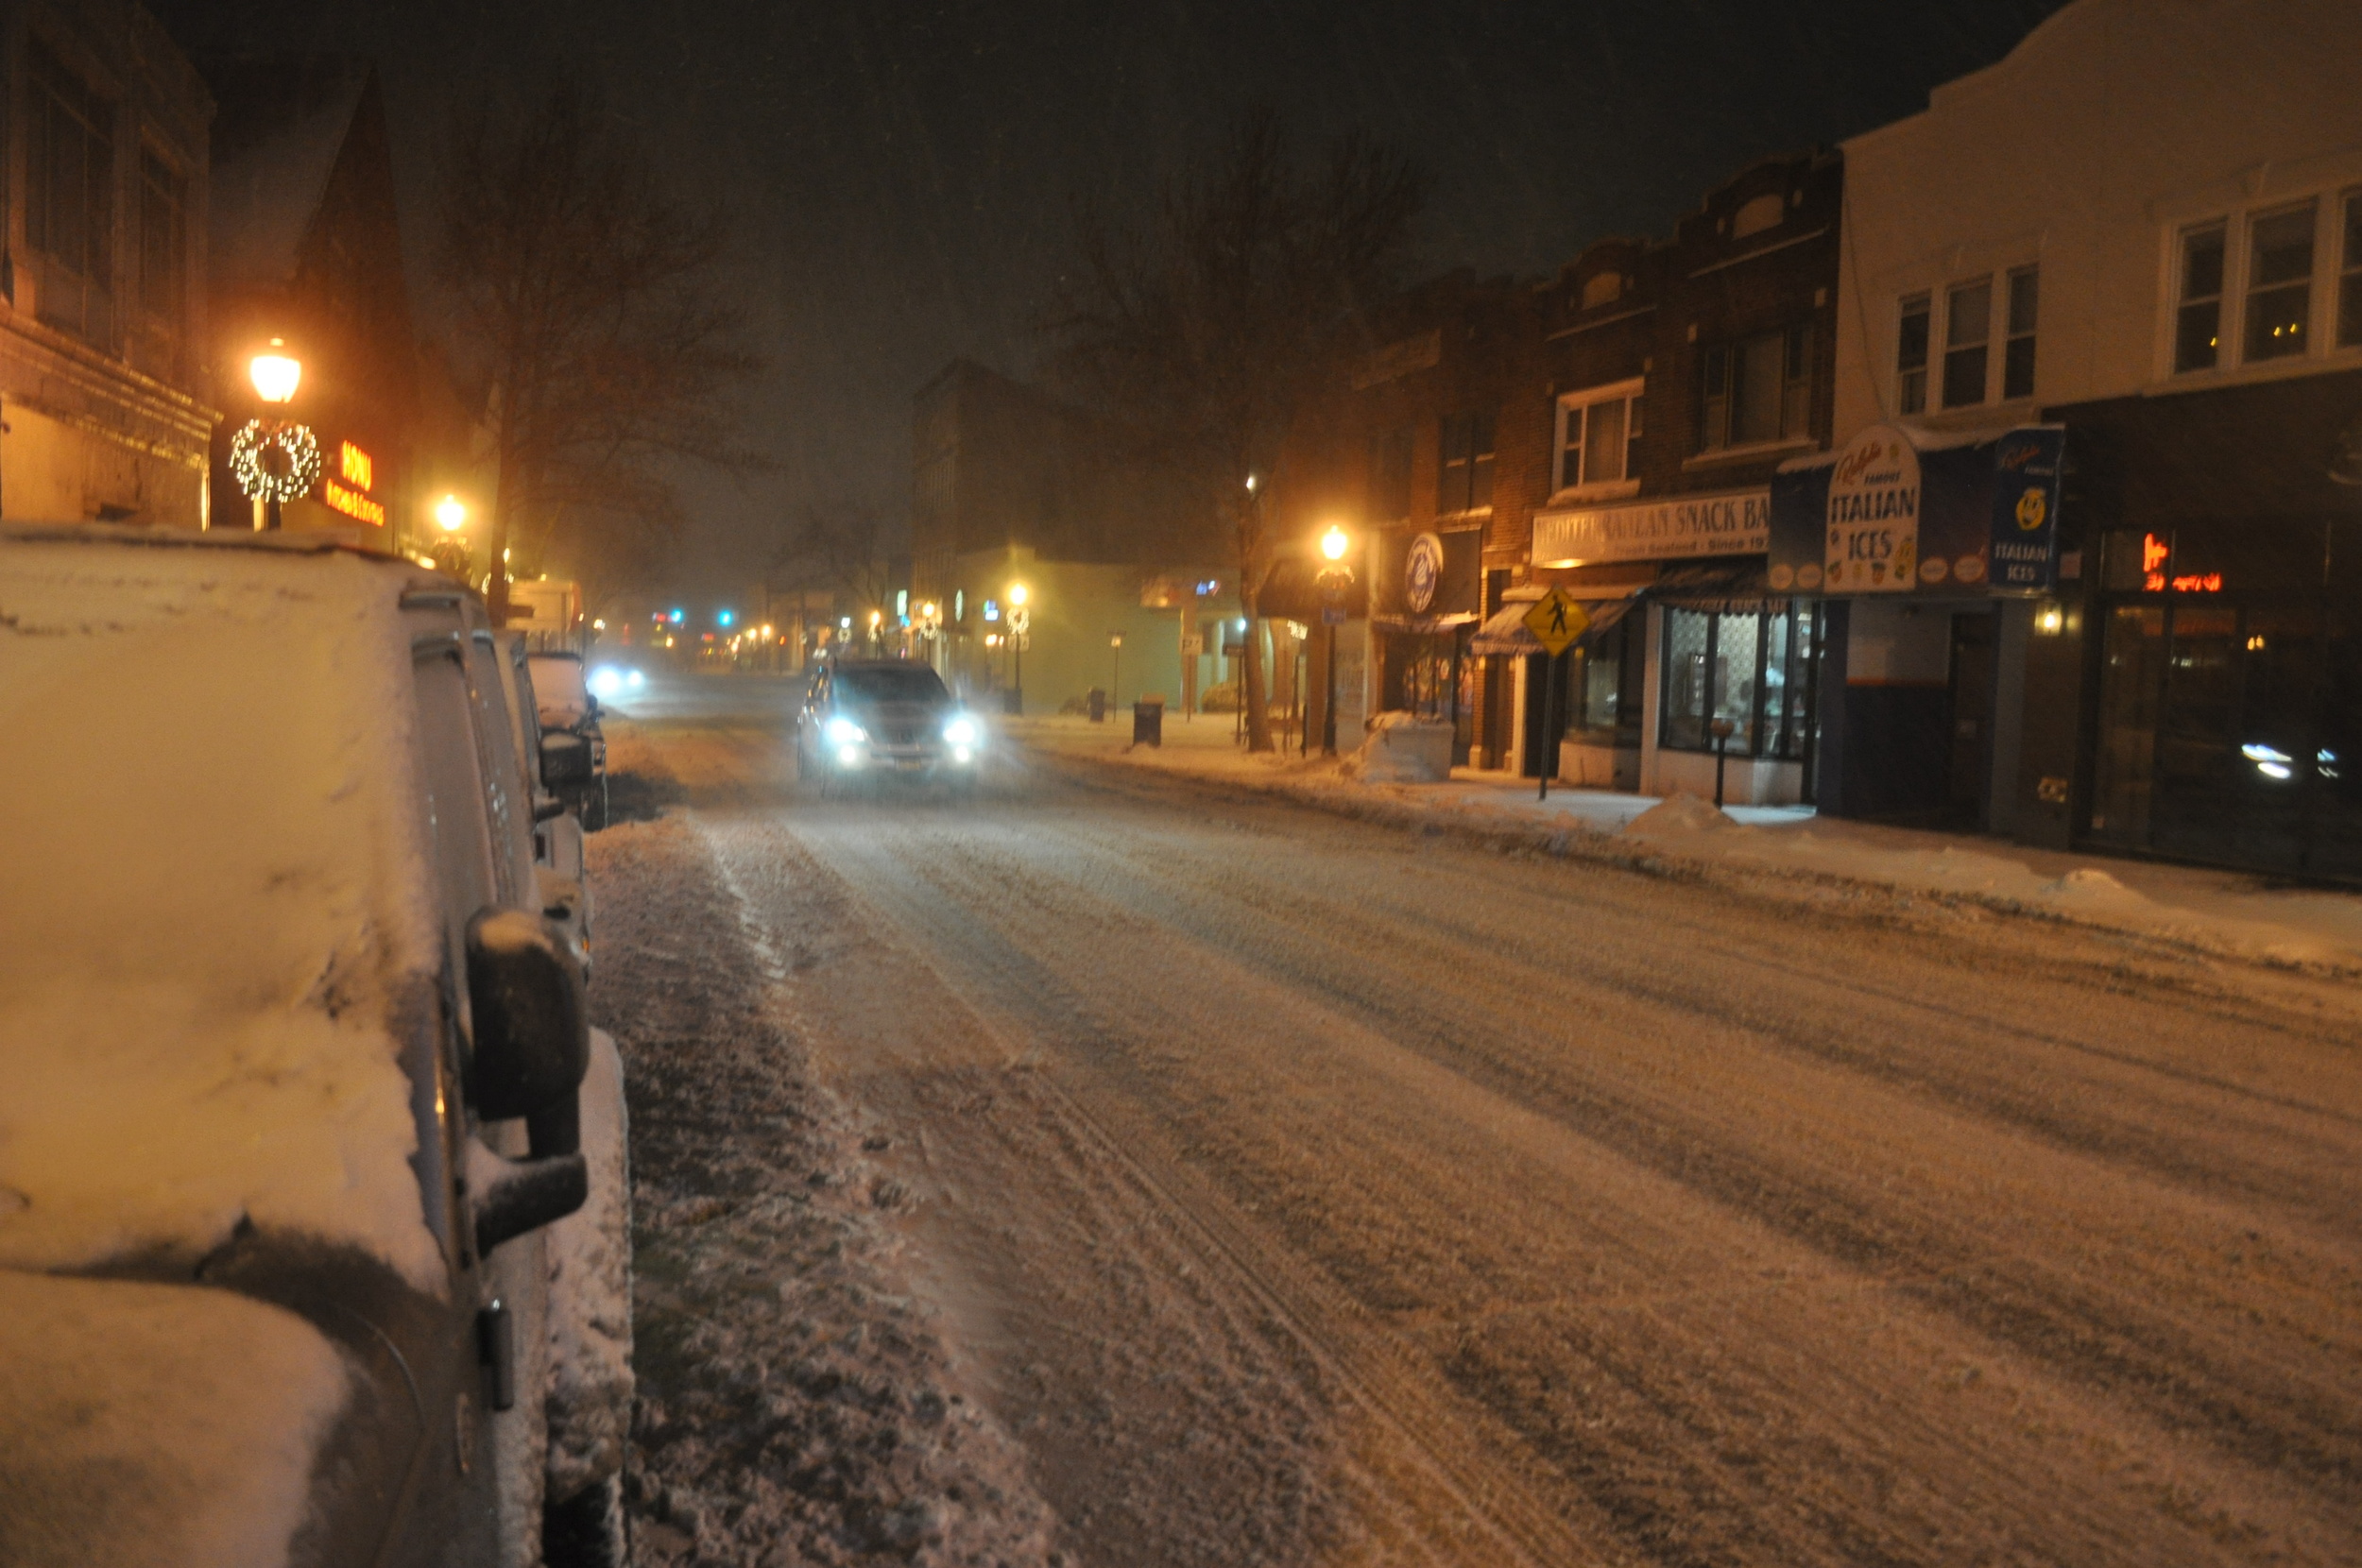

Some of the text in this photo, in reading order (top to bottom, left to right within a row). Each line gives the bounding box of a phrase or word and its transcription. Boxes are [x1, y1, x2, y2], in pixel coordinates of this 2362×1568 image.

[342, 440, 371, 491] HONU
[1676, 500, 1736, 535] SNACK
[1743, 497, 1770, 531] BA
[1831, 487, 1916, 524] ITALIAN
[1708, 537, 1744, 552] Since
[1847, 530, 1893, 559] ICES
[1994, 542, 2047, 562] ITALIAN
[2007, 563, 2036, 581] ICES
